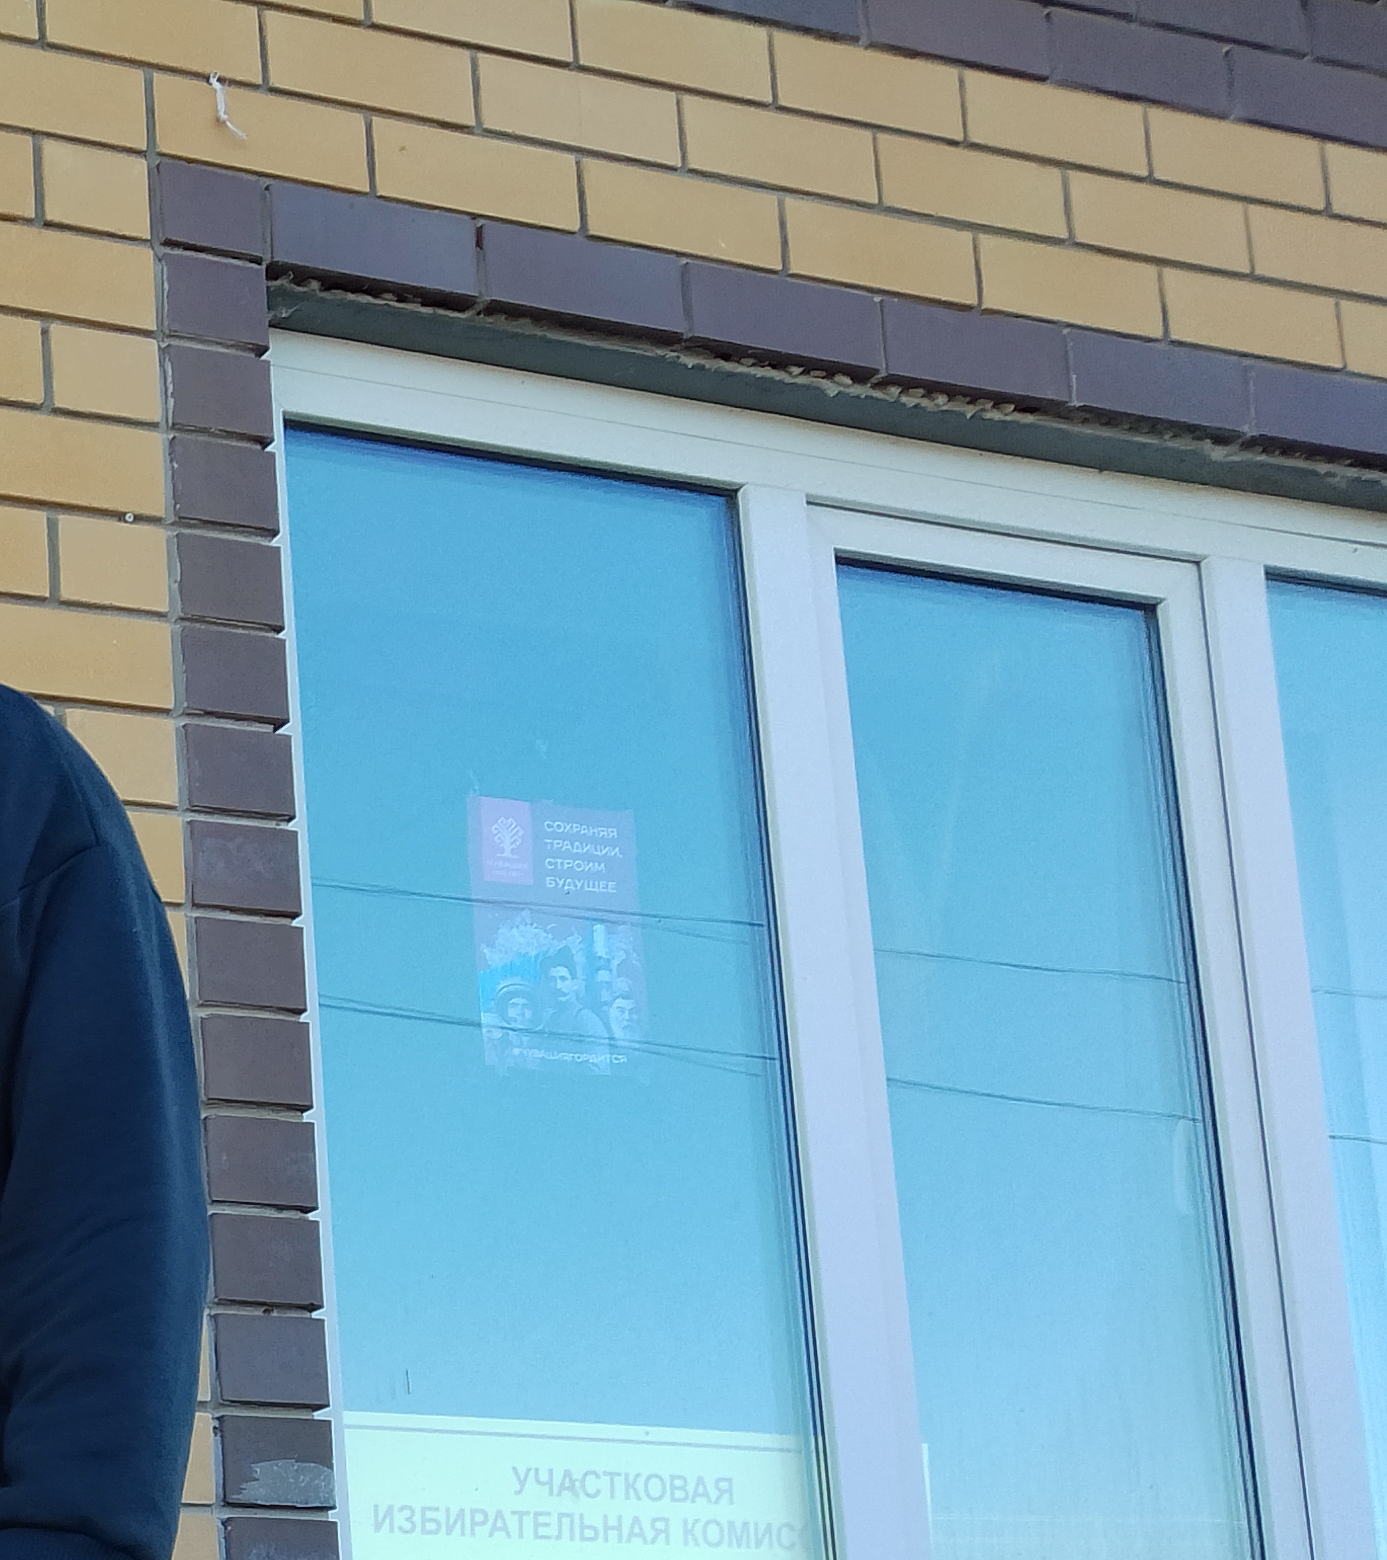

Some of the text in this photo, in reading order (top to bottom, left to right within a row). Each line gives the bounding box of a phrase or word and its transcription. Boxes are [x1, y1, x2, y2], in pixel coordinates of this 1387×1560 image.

[543, 820, 619, 839] СОХРАНЯЯ
[544, 857, 606, 873] СТРОИМ
[545, 876, 617, 893] БУДУЩЕЕ
[511, 1465, 736, 1507] УЧАСТКОВАЯ
[371, 1503, 670, 1547] ИЗБИРАТЕЛЬНАЯ
